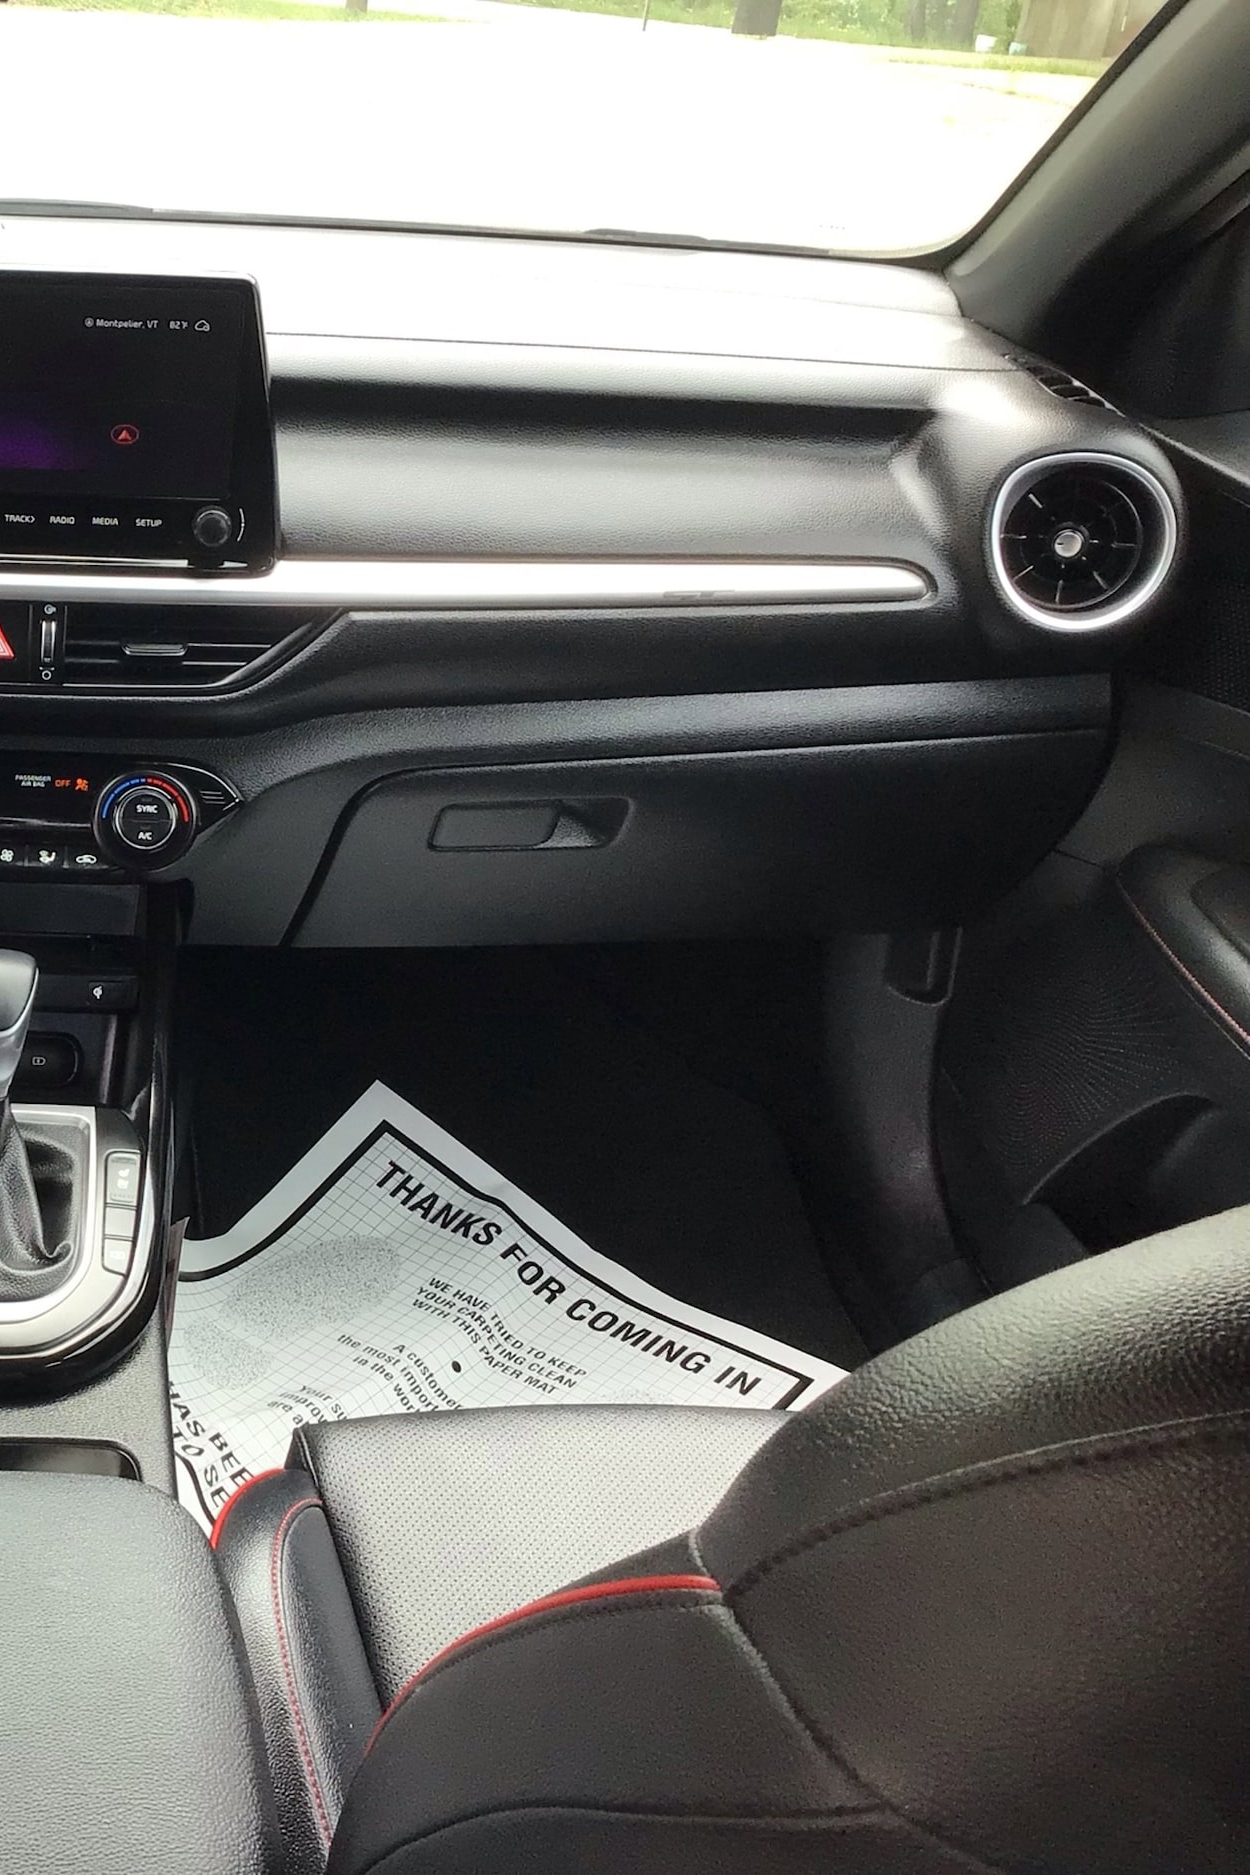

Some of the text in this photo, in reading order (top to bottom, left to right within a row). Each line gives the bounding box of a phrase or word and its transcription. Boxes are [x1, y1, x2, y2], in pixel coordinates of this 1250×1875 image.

[96, 319, 158, 329] Montpelier, VT
[49, 516, 75, 525] RADIO
[92, 517, 119, 526] MEDIA
[135, 518, 163, 527] SETUP
[55, 779, 71, 787] OFF
[136, 804, 158, 814] SYNC
[138, 832, 152, 841] A/C
[376, 1160, 762, 1396] THANKS FOR COMING IN
[429, 1277, 587, 1377] WE HAVE TRIED TO KEEP
[416, 1287, 577, 1388] YOUR CARPETING CLEAN
[337, 1334, 361, 1348] the
[363, 1345, 400, 1366] most
[392, 1343, 406, 1354] A
[412, 1299, 559, 1395] WITH THIS PAPER MAT
[353, 1355, 368, 1367] in
[370, 1362, 394, 1382] the
